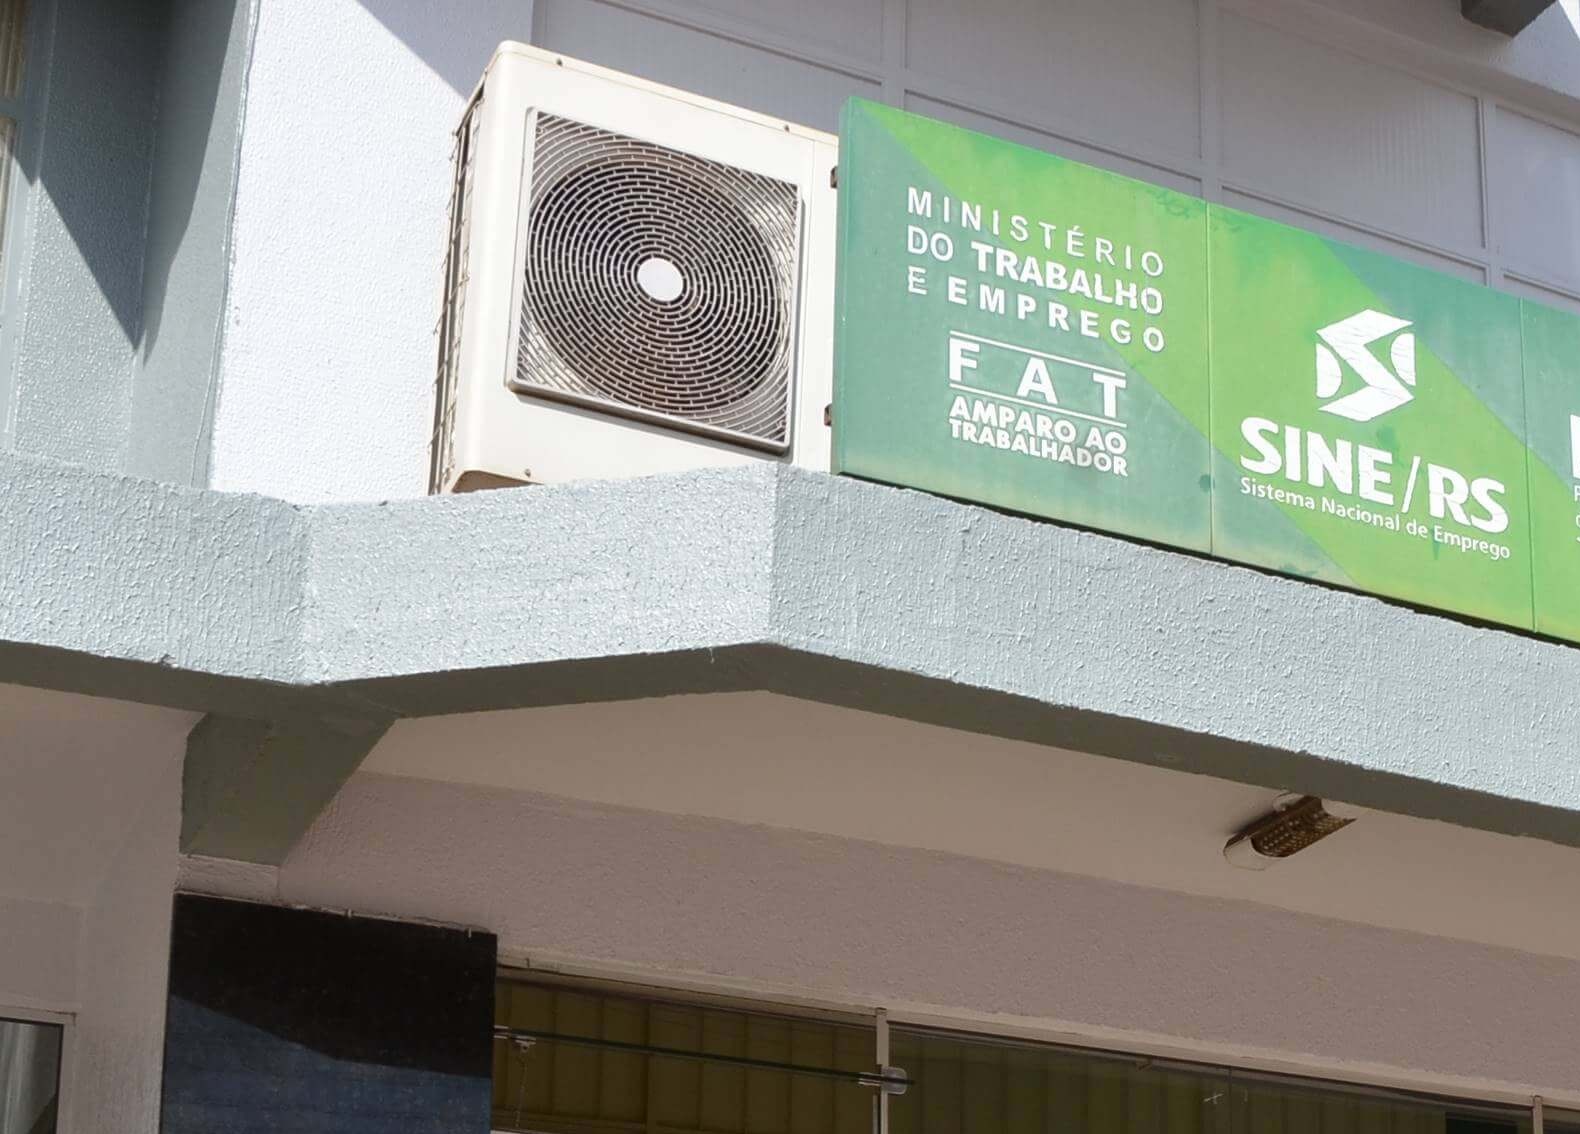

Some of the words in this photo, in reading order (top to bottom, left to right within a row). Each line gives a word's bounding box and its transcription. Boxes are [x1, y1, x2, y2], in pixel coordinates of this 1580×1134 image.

[907, 225, 954, 262] DO
[971, 241, 1164, 315] TRABALHO
[908, 186, 1164, 277] MINISTÉRIO
[908, 266, 928, 295] E
[949, 279, 1165, 353] EMPREGO
[949, 396, 1077, 443] AMPARO
[1085, 426, 1127, 455] AO
[949, 419, 1128, 477] TRABALHADOR
[1240, 417, 1509, 534] SINE/RS
[1240, 476, 1316, 512] Sistema
[1322, 498, 1400, 532] Nacional
[1406, 519, 1428, 539] de
[1434, 525, 1511, 561] Emprego
